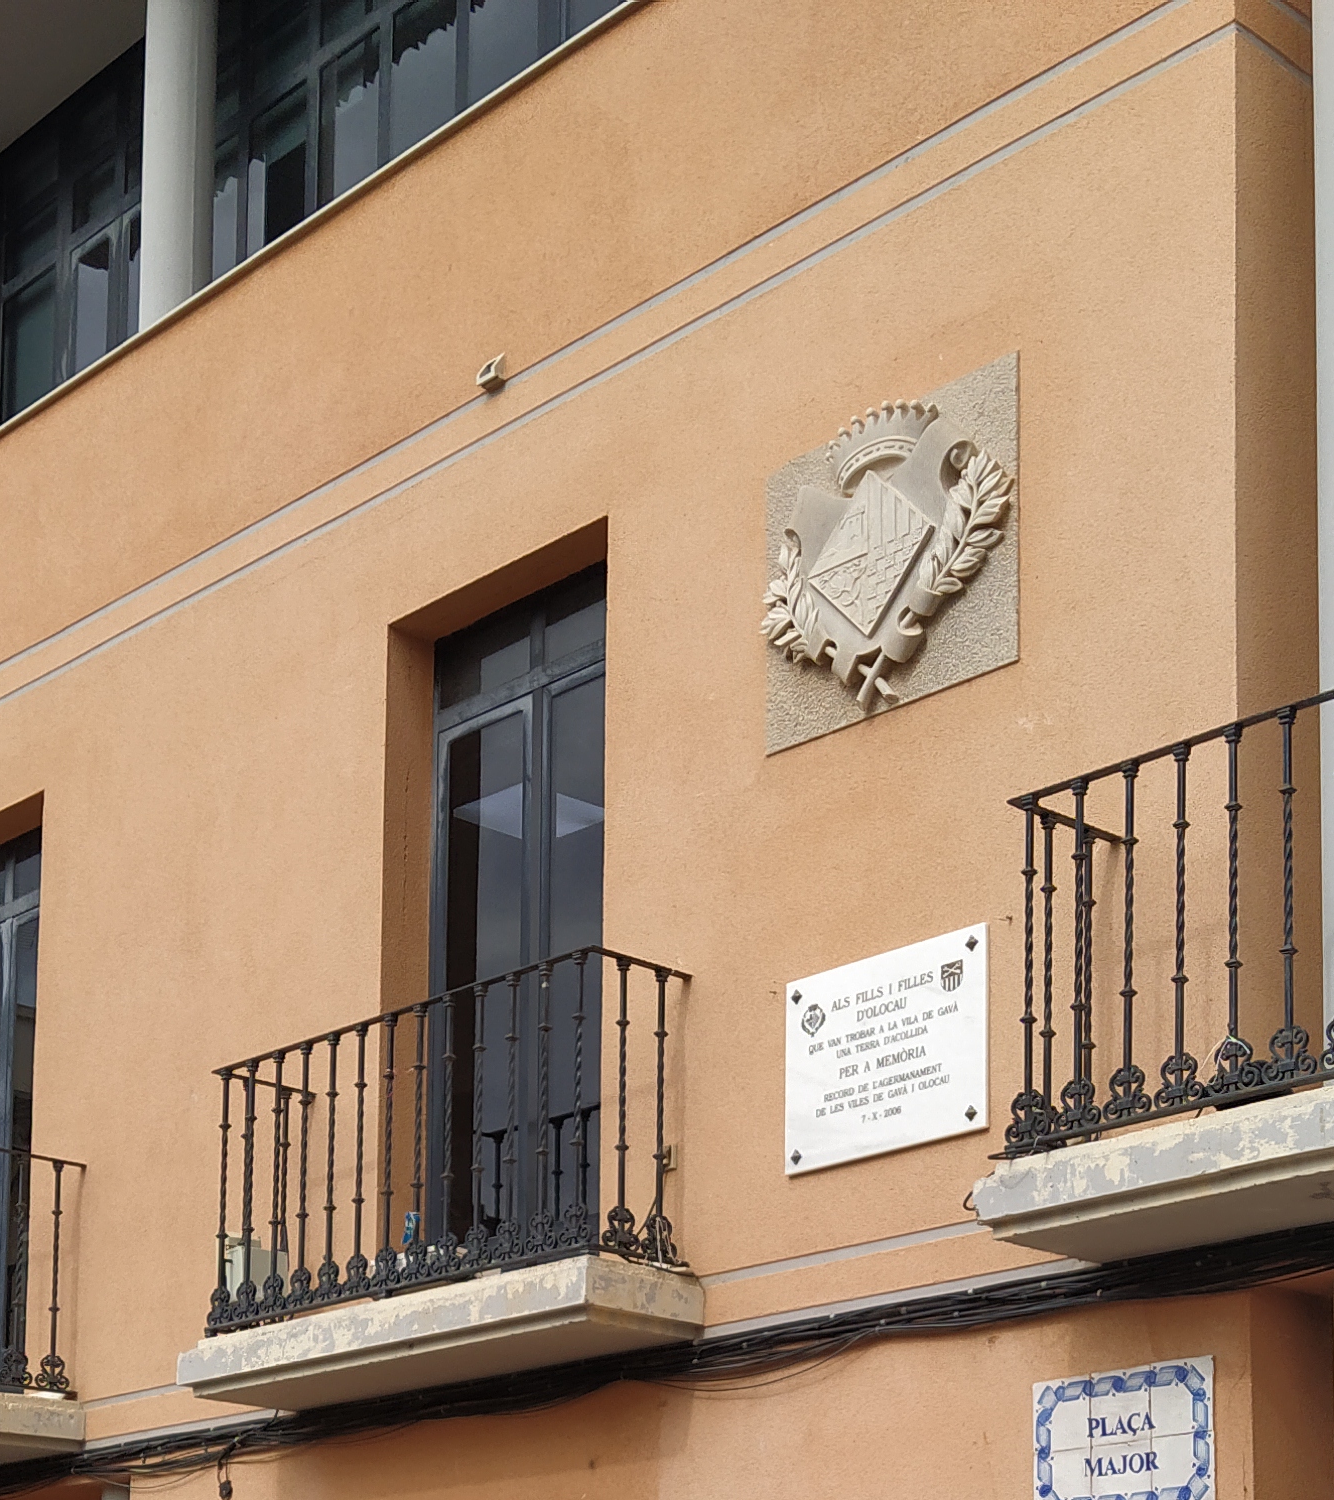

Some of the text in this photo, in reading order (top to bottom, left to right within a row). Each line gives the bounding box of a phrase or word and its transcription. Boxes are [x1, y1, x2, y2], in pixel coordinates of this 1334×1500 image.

[831, 971, 934, 1012] ALS FILLS I FILLES
[856, 996, 907, 1022] D'OLOCAU
[808, 1041, 824, 1056] QUE
[827, 1037, 842, 1049] VAN
[845, 1027, 876, 1043] TROBAR
[878, 1024, 885, 1034] A
[887, 1020, 898, 1031] LA
[901, 1014, 919, 1027] VILA
[922, 1009, 934, 1021] DE
[835, 1025, 929, 1059] UNA TERRA D'ACOLLIDA
[839, 1045, 927, 1080] PER A MEMÒRIA
[815, 1107, 827, 1118] DE
[829, 1102, 845, 1114] LES
[847, 1096, 870, 1109] VILES
[872, 1092, 884, 1103] DE
[918, 1074, 950, 1091] OLOCAU
[823, 1087, 855, 1103] RECORD
[857, 1083, 869, 1094] DE
[1087, 1411, 1156, 1438] PLAÇA
[1083, 1451, 1159, 1478] MAJOR
